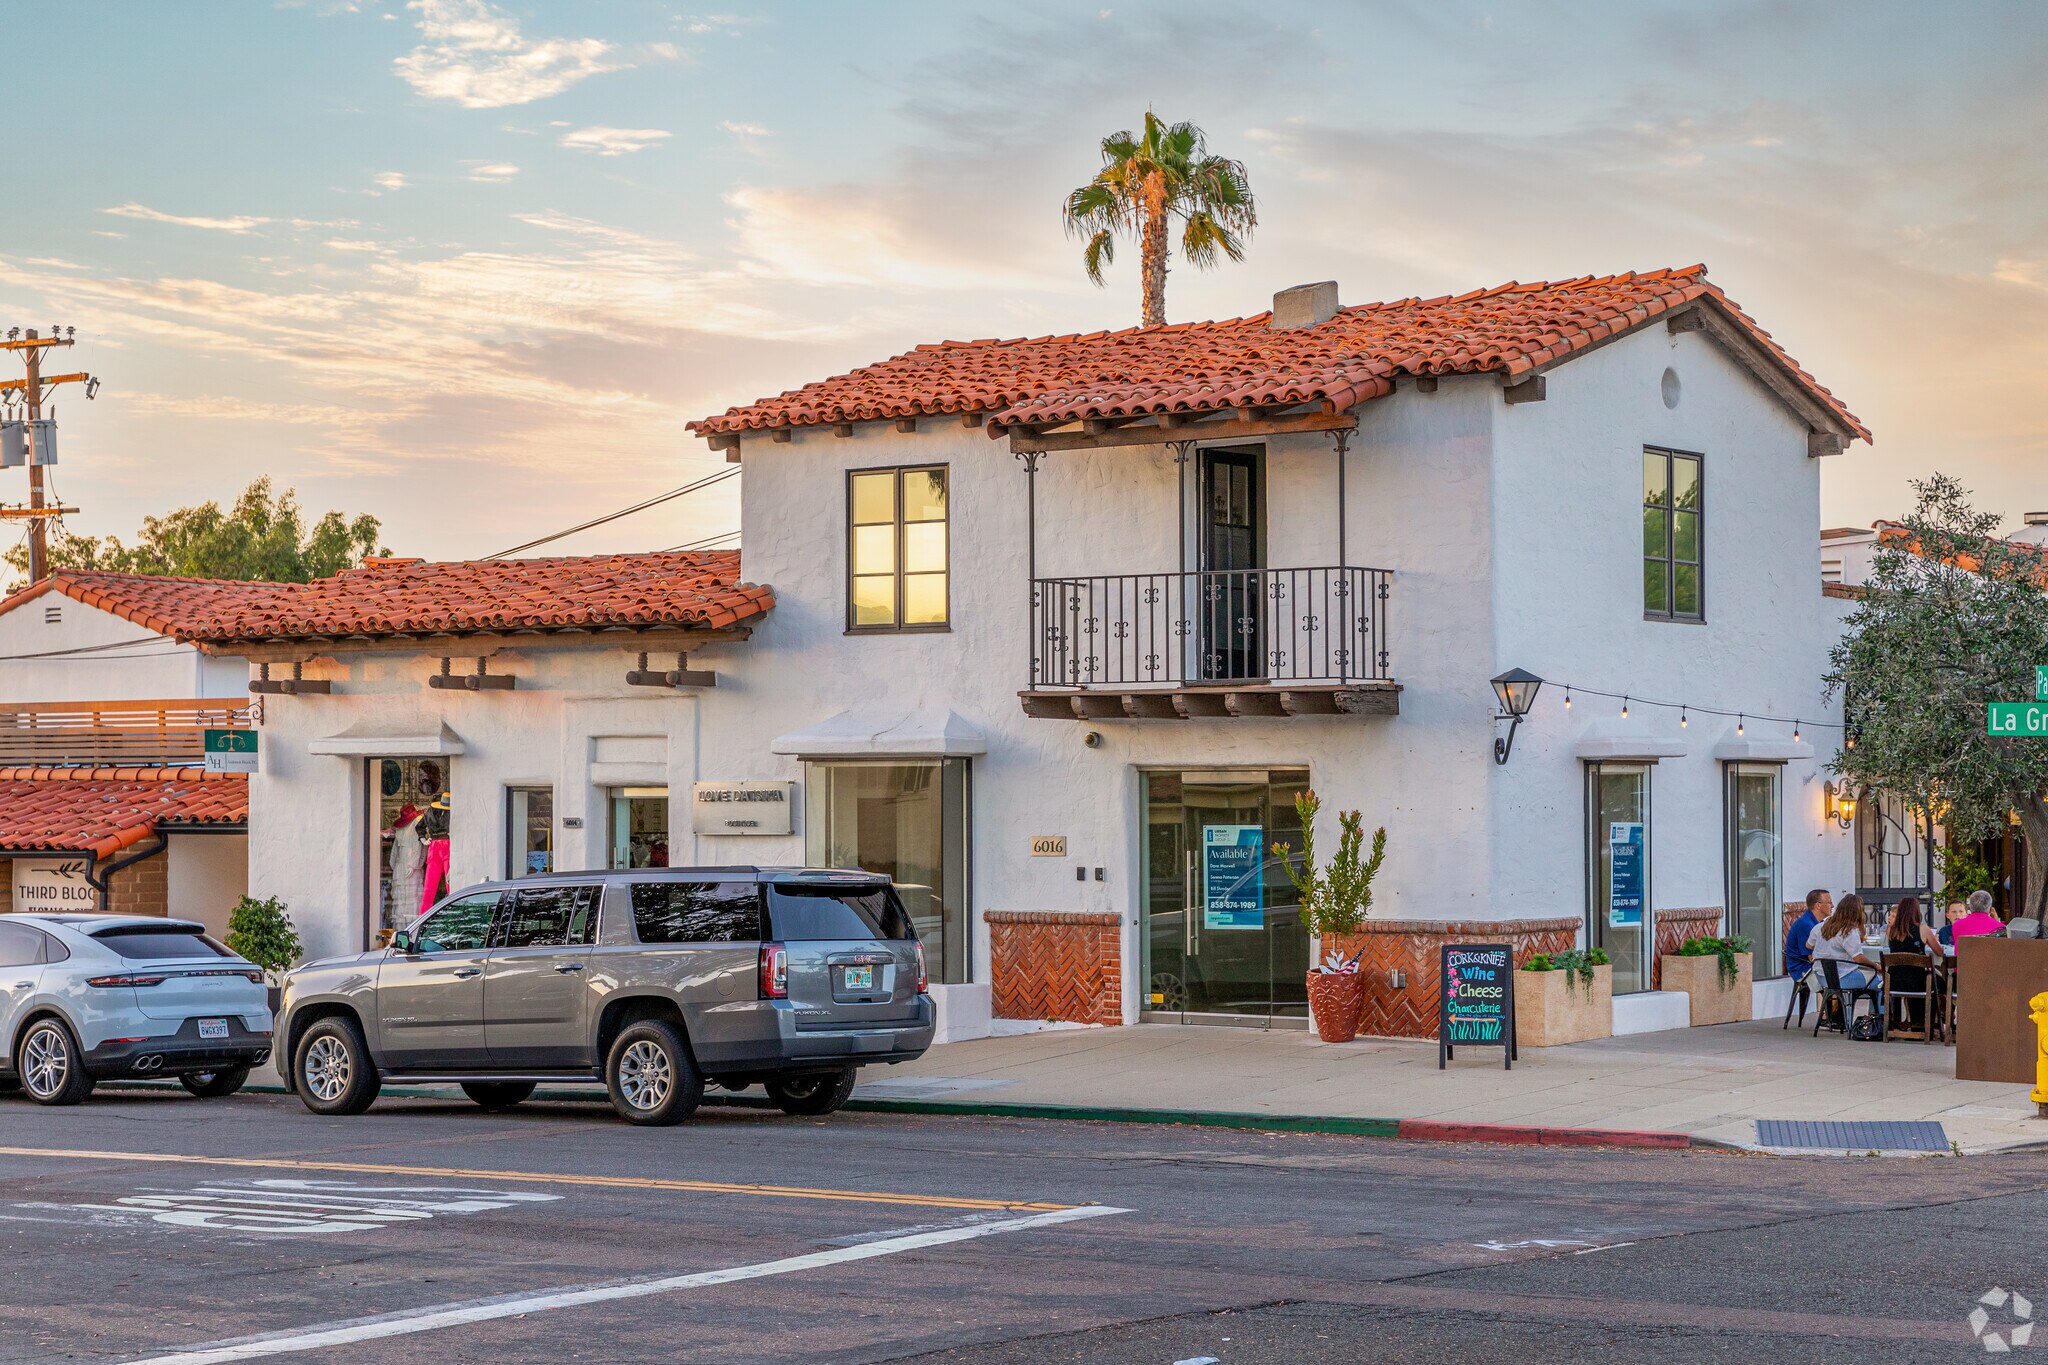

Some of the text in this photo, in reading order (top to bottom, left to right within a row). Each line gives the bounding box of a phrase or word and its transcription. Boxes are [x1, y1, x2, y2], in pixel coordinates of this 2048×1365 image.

[1992, 708, 2016, 731] La
[699, 790, 732, 802] LOVE
[1033, 840, 1063, 853] 6016
[1209, 848, 1248, 859] Available
[19, 885, 57, 899] THIRD
[1210, 901, 1257, 909] 858-874-1989
[1448, 952, 1506, 967] CORK&KNIFE
[1461, 966, 1495, 981] Wine
[1459, 983, 1503, 998] Cheese
[1448, 1000, 1501, 1014] Charcuterie
